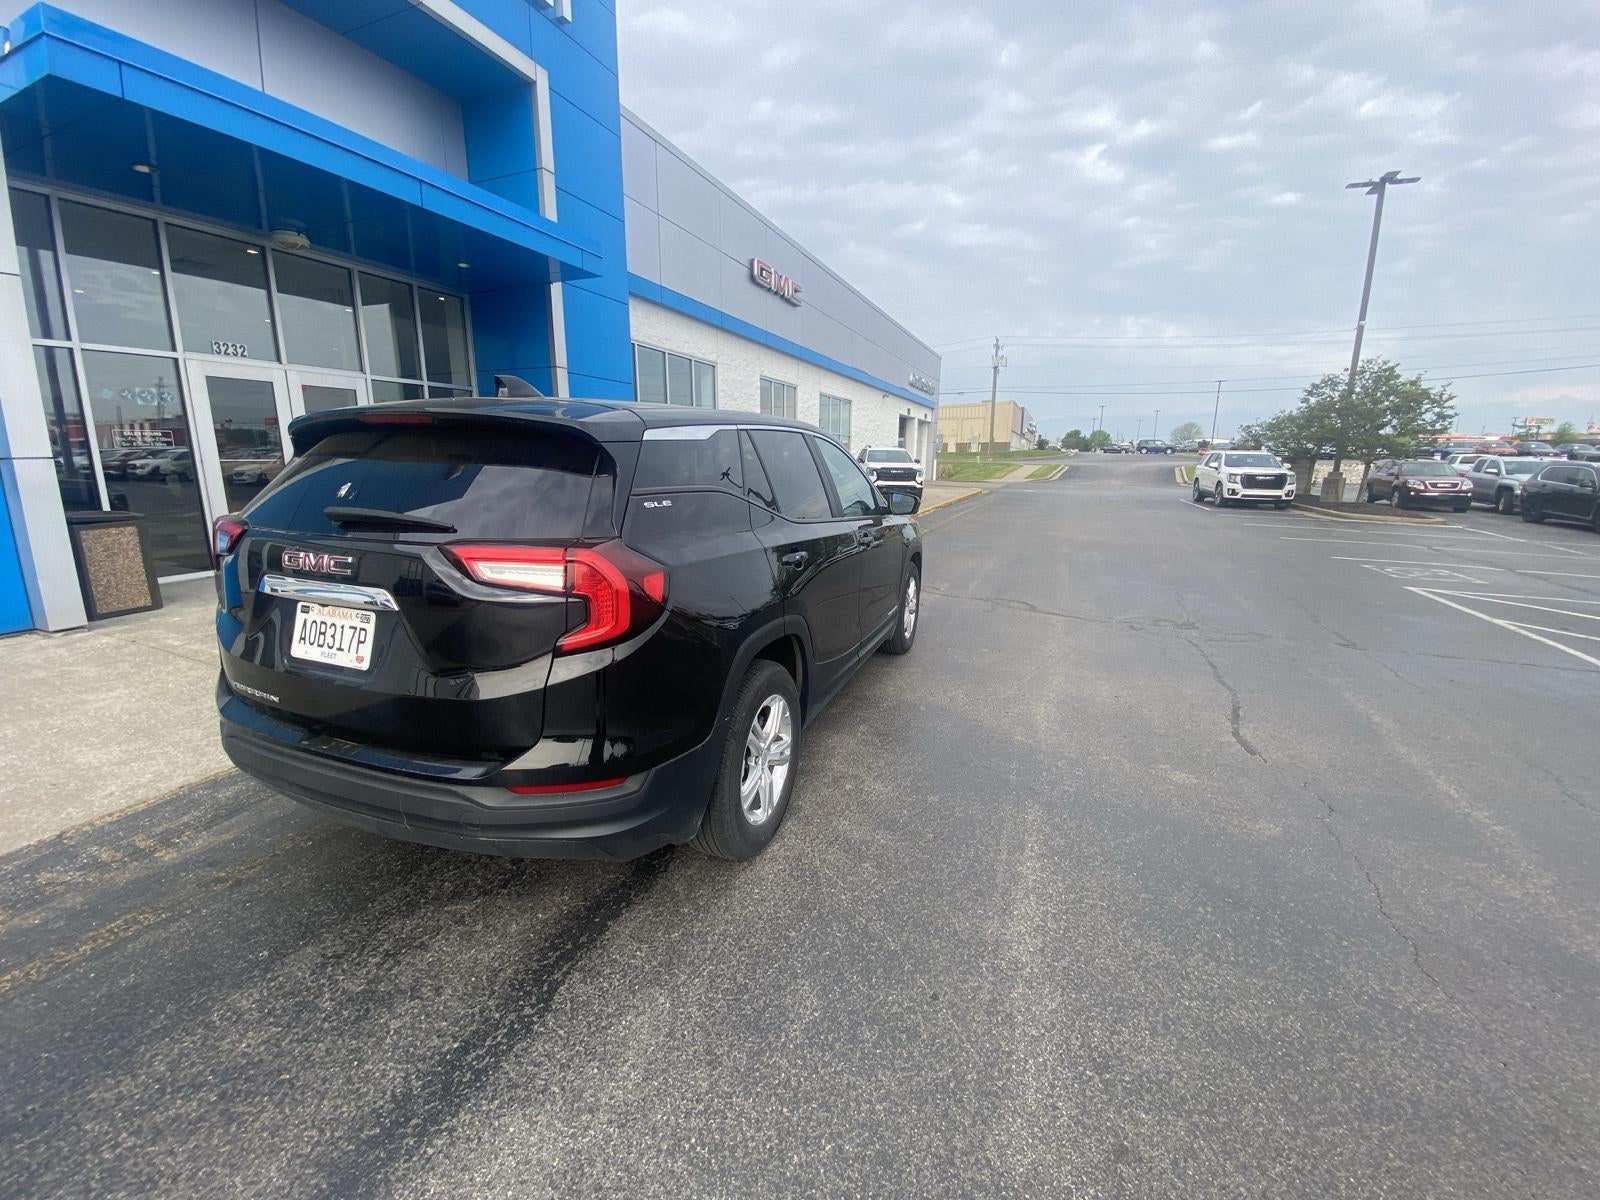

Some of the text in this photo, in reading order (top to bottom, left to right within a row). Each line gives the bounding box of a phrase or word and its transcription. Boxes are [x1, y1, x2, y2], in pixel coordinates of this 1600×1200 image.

[752, 257, 802, 306] GMC
[214, 341, 248, 358] 3232
[643, 500, 673, 509] SLE
[281, 550, 353, 576] GMC
[316, 607, 353, 621] ALABAMA
[320, 651, 337, 660] FLEET
